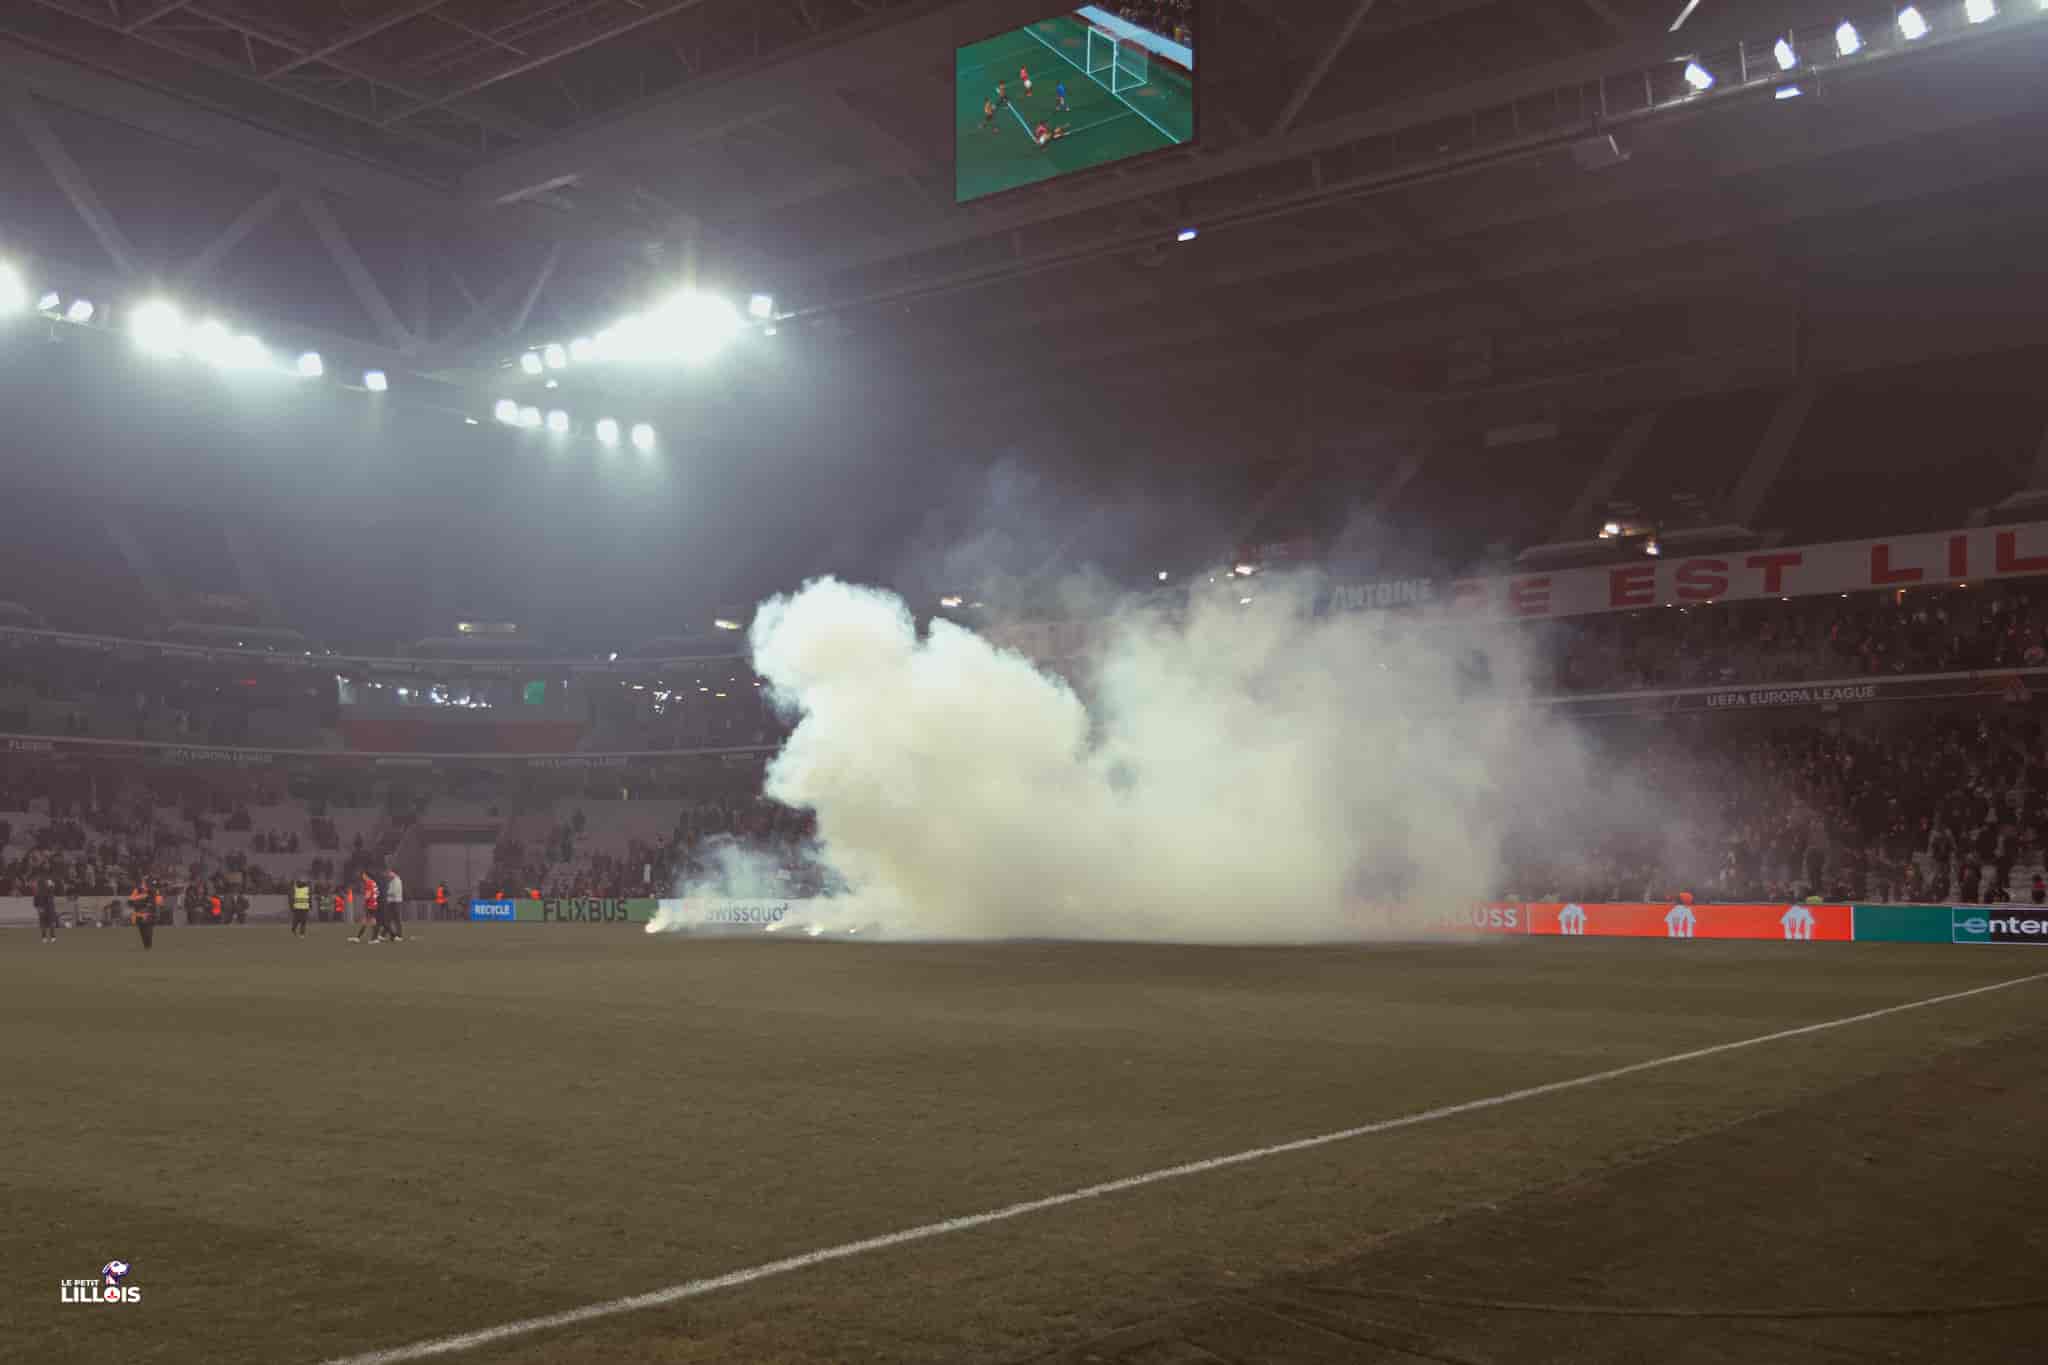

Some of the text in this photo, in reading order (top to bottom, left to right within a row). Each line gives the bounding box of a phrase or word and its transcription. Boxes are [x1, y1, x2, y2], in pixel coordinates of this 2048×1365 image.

[1609, 553, 1803, 607] EST
[1871, 532, 2048, 584] LIL
[1707, 685, 1875, 706] UEFA EUROPA LEAGUE
[474, 904, 510, 915] RECYCLE
[1964, 916, 2048, 935] enter
